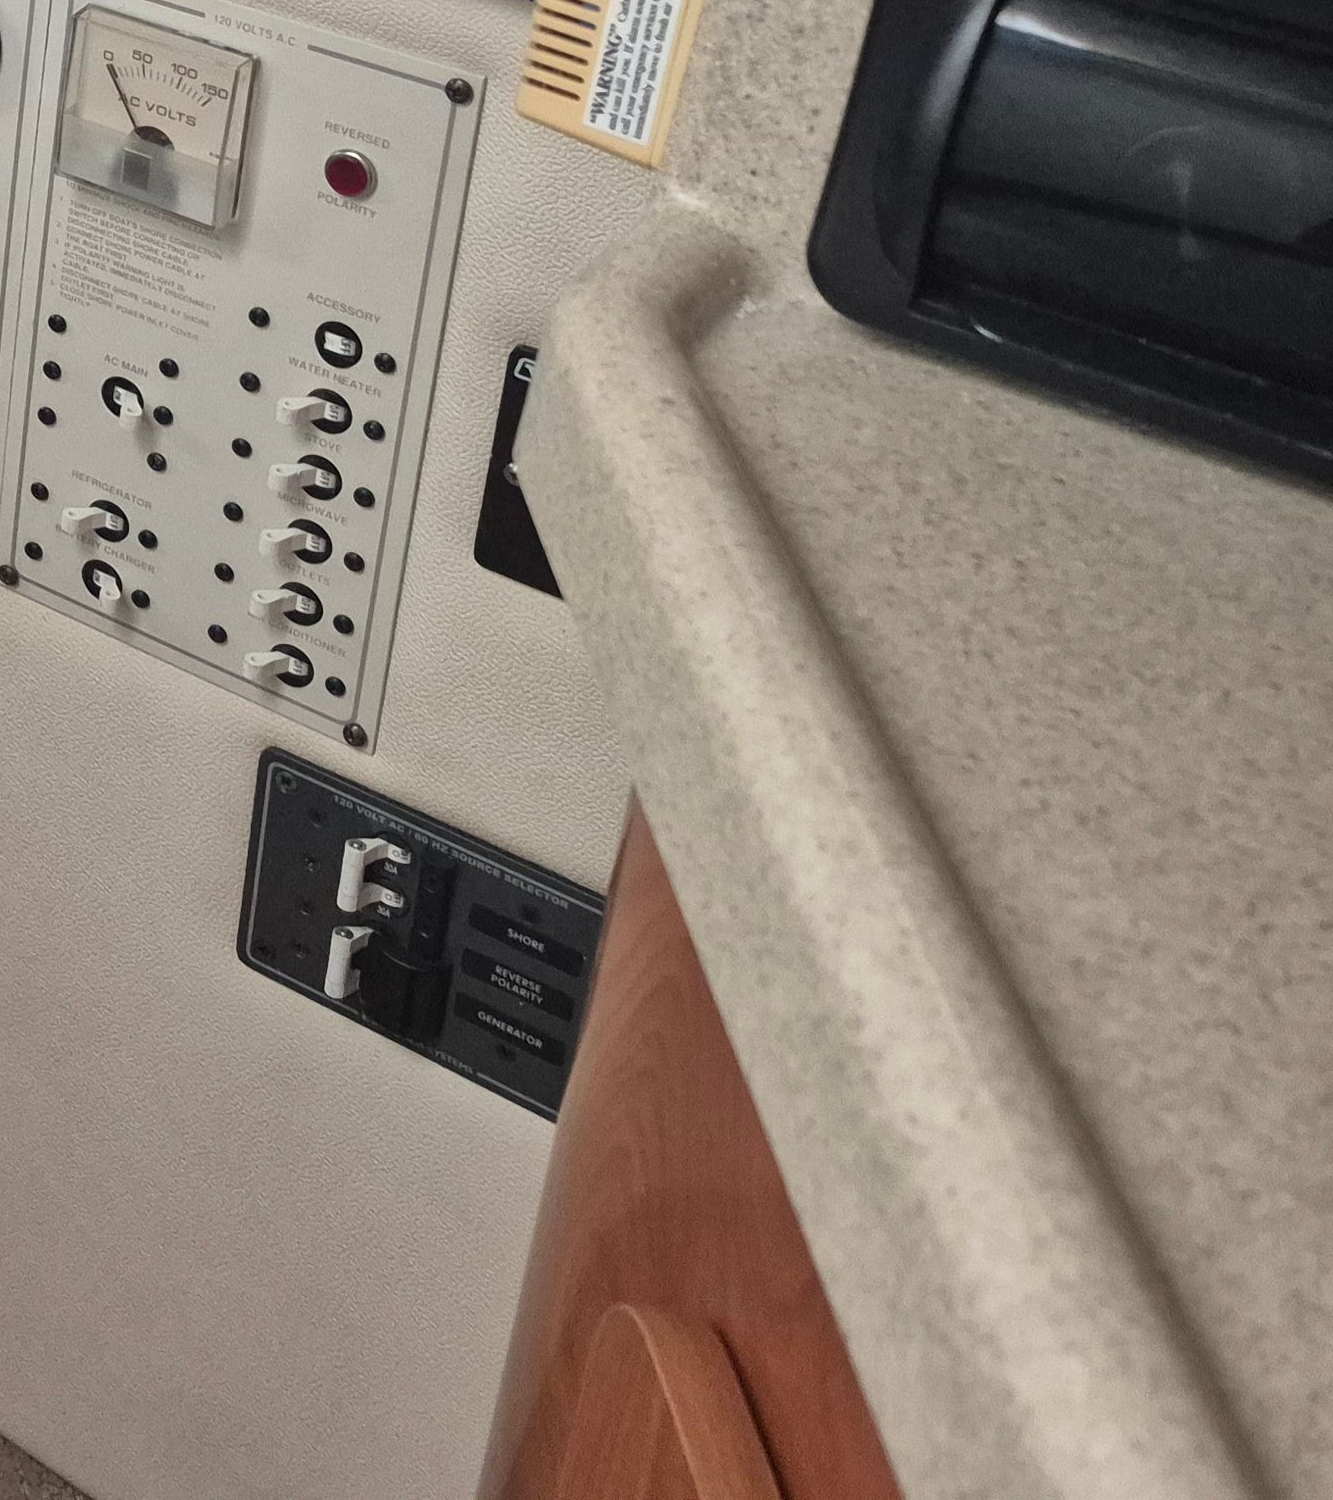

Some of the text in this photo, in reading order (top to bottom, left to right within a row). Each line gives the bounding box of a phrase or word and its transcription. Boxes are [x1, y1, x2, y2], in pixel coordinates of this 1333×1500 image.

[214, 14, 273, 40] 120 VOLTS
[103, 49, 229, 100] 0 50 100 150
[145, 100, 197, 127] VOLTS
[324, 121, 390, 149] REVERSED
[317, 191, 377, 218] POLARITY
[306, 292, 381, 323] ACCESSORY
[104, 354, 148, 377] AC MAIN
[288, 356, 381, 397] WATER HEATER
[71, 469, 152, 509] REFRIGERATOR
[277, 491, 347, 525] MICROWAVE
[103, 545, 155, 574] CHARGER
[334, 795, 353, 809] 120
[357, 805, 387, 824] VOLT
[389, 821, 405, 833] AC
[414, 833, 429, 844] 60
[452, 850, 502, 878] SOURCE
[504, 873, 570, 910] SELECTOR
[507, 927, 545, 953] SHORE
[491, 973, 543, 1004] POLARITY
[495, 964, 542, 994] REVERSE
[477, 1010, 543, 1049] GENERATOR
